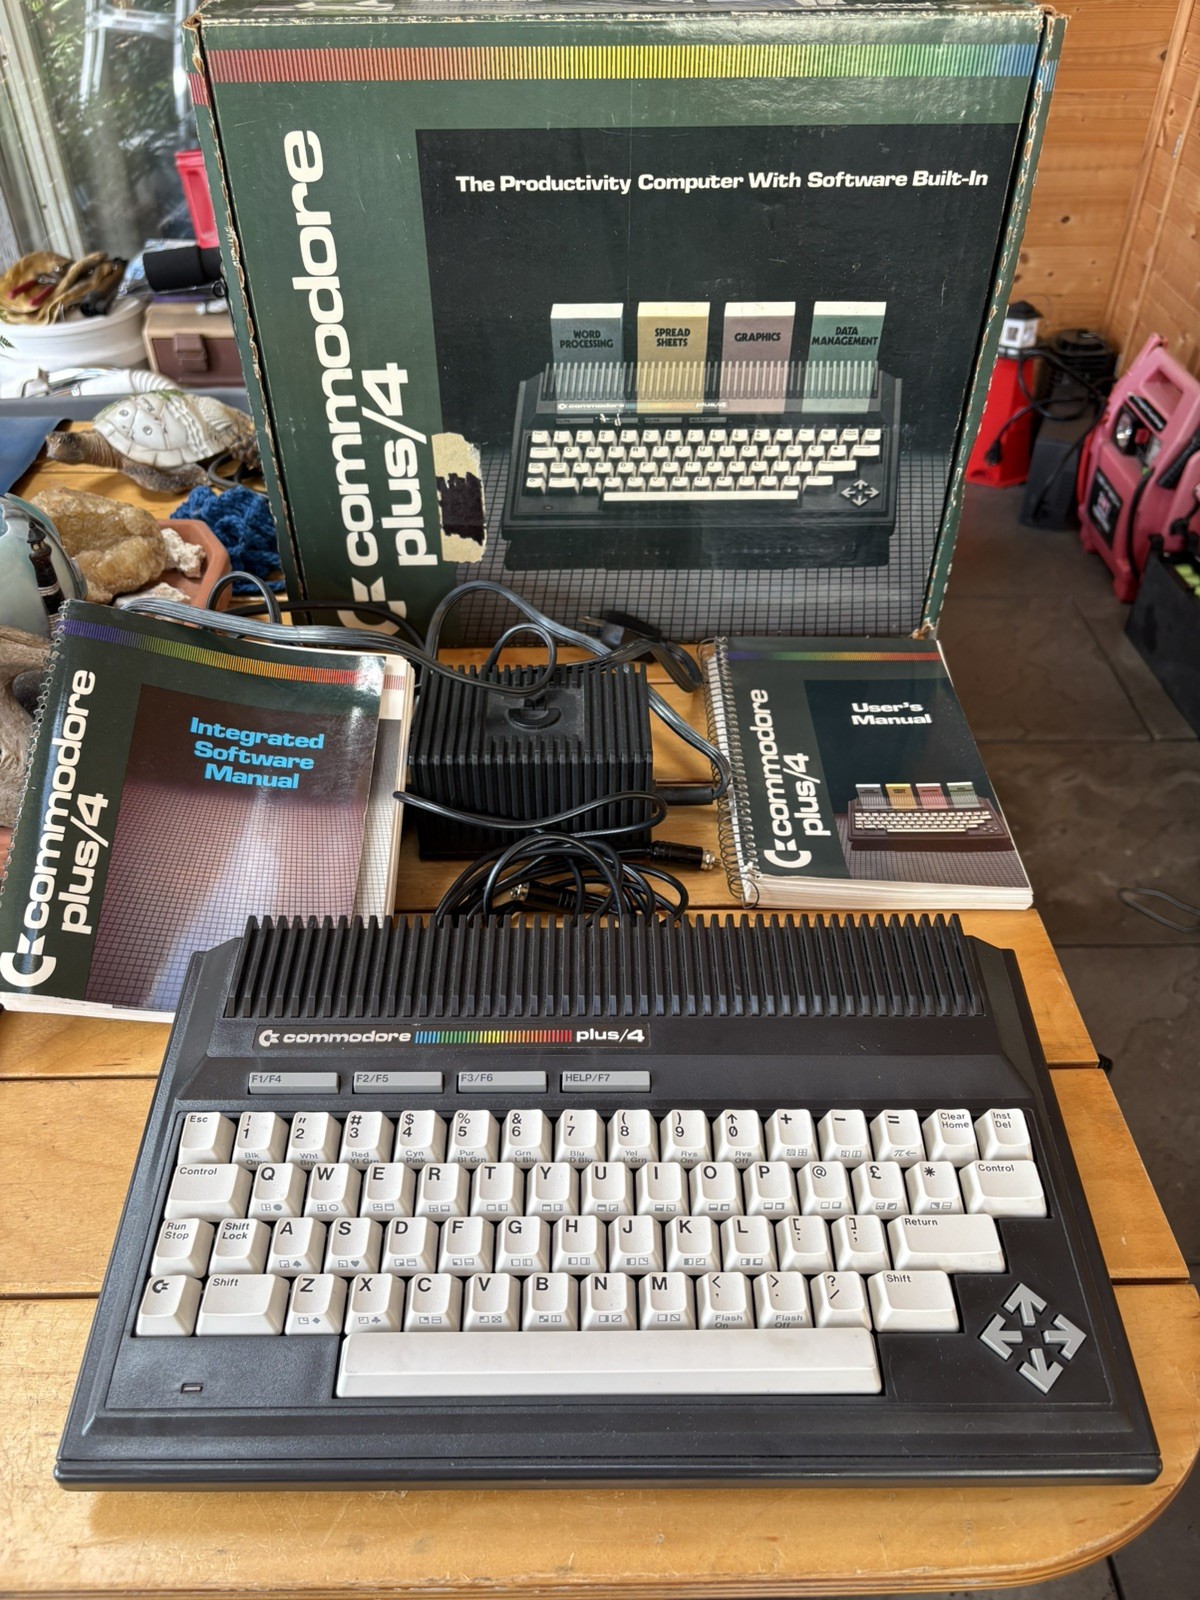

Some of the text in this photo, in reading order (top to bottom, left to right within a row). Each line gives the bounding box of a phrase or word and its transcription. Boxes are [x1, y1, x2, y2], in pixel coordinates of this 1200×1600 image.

[456, 170, 988, 195] The Productivity Computer With Software Built-In
[655, 328, 690, 337] SPREAD
[836, 327, 858, 335] DATA
[560, 339, 613, 348] PROCESSING
[657, 338, 687, 347] SHEETS
[735, 333, 781, 342] GRAPHICS
[812, 337, 878, 345] MANAGEMENT
[284, 130, 378, 566] commodore
[362, 362, 437, 566] plus/4
[852, 702, 924, 715] User's
[852, 714, 932, 727] Manual
[190, 717, 324, 750] Integrated
[194, 740, 314, 771] Software
[749, 689, 793, 836] commodore
[204, 763, 299, 790] Manual
[24, 669, 96, 928] commodore
[783, 752, 831, 837] plus/4
[58, 791, 109, 935] plus/4
[283, 1029, 645, 1044] commodore plus/4
[251, 1075, 282, 1083] F1/F4
[356, 1074, 388, 1083] F2/F5
[461, 1074, 494, 1082] F3/F6
[565, 1074, 611, 1082] HELP/F7
[190, 1115, 208, 1123] Esc
[246, 1115, 252, 1126] !
[350, 1115, 363, 1125] #
[405, 1113, 414, 1125] $
[458, 1113, 471, 1124] %
[512, 1113, 522, 1124] &
[621, 1112, 626, 1124] (
[677, 1112, 682, 1125] )
[780, 1114, 792, 1124] +
[887, 1115, 900, 1124] =
[244, 1128, 250, 1139] 1
[295, 1129, 305, 1140] 2
[350, 1128, 359, 1138] 3
[403, 1127, 412, 1138] 4
[458, 1126, 467, 1137] 5
[512, 1126, 521, 1136] 6
[567, 1126, 575, 1136] 7
[620, 1125, 630, 1136] 8
[675, 1126, 684, 1137] 9
[729, 1126, 738, 1137] 0
[180, 1167, 217, 1175] Control
[261, 1167, 275, 1180] Q
[318, 1167, 335, 1180] W
[373, 1167, 385, 1180] E
[429, 1167, 441, 1180] R
[484, 1166, 496, 1179] T
[540, 1166, 552, 1179] Y
[595, 1166, 606, 1180] U
[704, 1166, 717, 1179] O
[759, 1166, 770, 1178] P
[812, 1166, 826, 1179] @
[869, 1165, 882, 1180] £
[280, 1222, 293, 1235] A
[338, 1221, 352, 1235] S
[395, 1221, 408, 1234] D
[452, 1221, 464, 1233] F
[508, 1220, 522, 1234] G
[566, 1220, 578, 1233] H
[623, 1220, 632, 1233] J
[679, 1220, 692, 1233] K
[737, 1220, 748, 1233] L
[793, 1219, 800, 1230] [
[849, 1218, 856, 1229] ]
[164, 1232, 189, 1240] Stop
[213, 1278, 239, 1286] Shift
[300, 1278, 315, 1292] Z
[359, 1278, 372, 1291] X
[418, 1278, 432, 1292] C
[478, 1277, 491, 1291] V
[536, 1277, 548, 1290] B
[594, 1277, 607, 1290] N
[652, 1277, 667, 1290] M
[712, 1276, 721, 1288] <
[770, 1275, 779, 1287] >
[827, 1275, 836, 1286] ?
[830, 1289, 839, 1299] /
